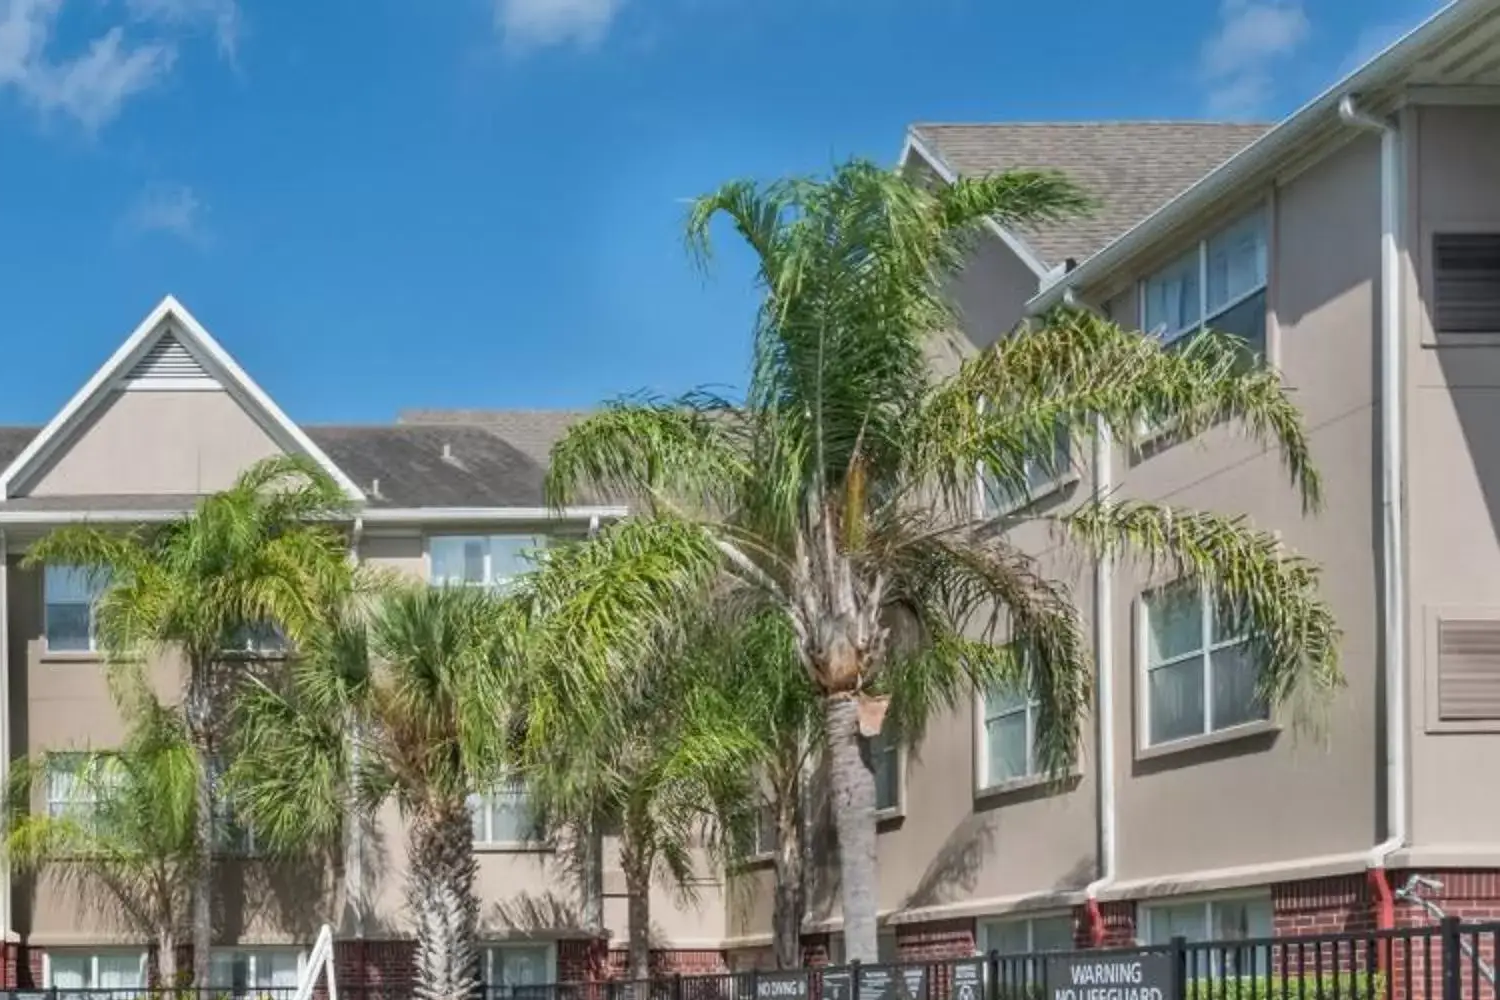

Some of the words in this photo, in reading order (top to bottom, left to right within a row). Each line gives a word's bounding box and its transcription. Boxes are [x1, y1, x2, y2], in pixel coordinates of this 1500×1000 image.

[1071, 962, 1143, 985] WARNING
[757, 981, 770, 997] NO
[771, 980, 797, 997] DIVING
